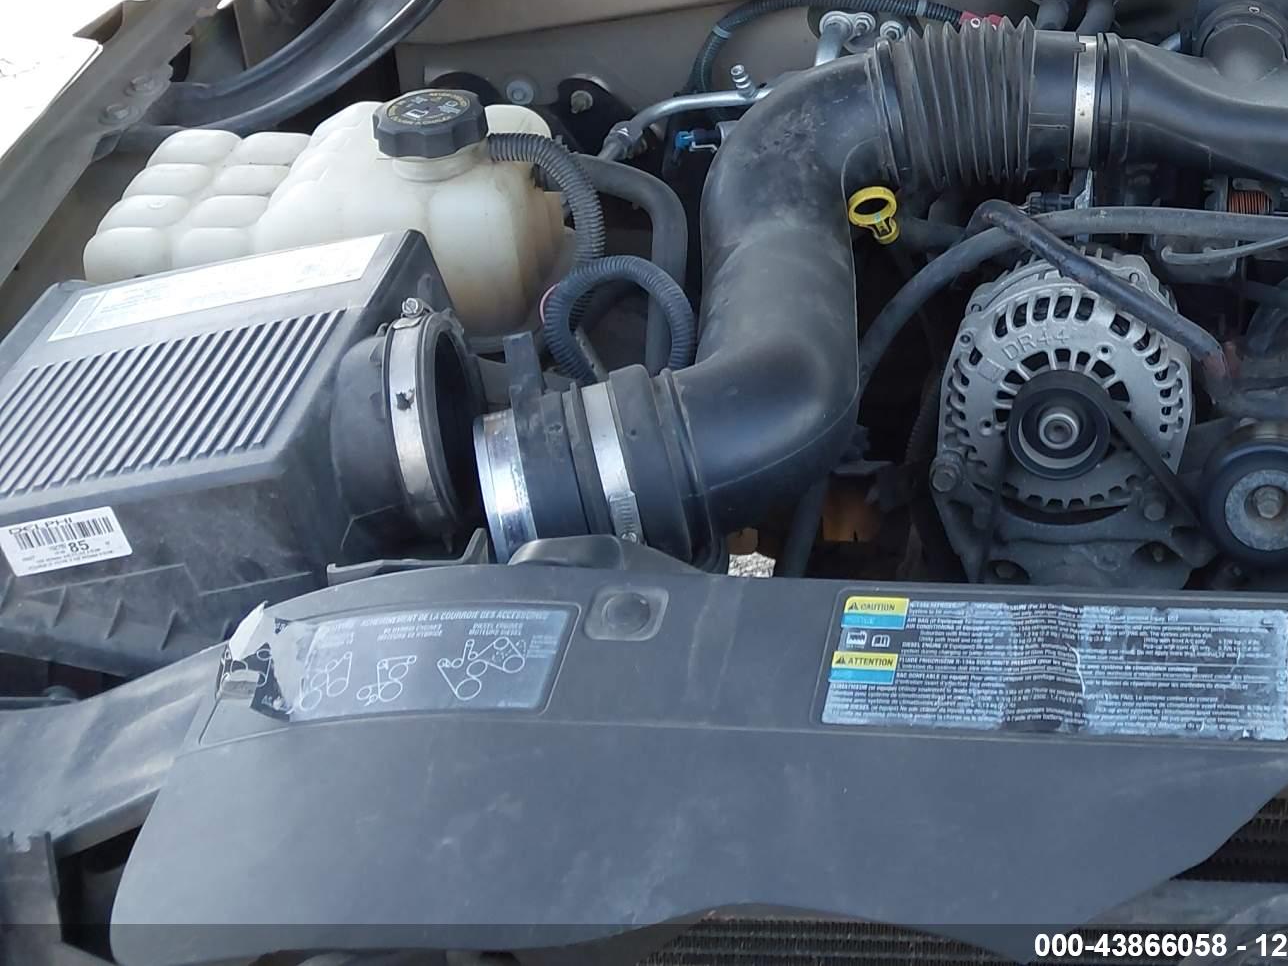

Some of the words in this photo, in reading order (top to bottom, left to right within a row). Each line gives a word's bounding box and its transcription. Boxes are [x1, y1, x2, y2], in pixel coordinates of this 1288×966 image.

[1001, 326, 1070, 361] DR44
[9, 517, 72, 535] DELPHI
[68, 540, 90, 553] 85
[860, 602, 895, 611] CAUTION
[848, 657, 895, 667] ATTENTION
